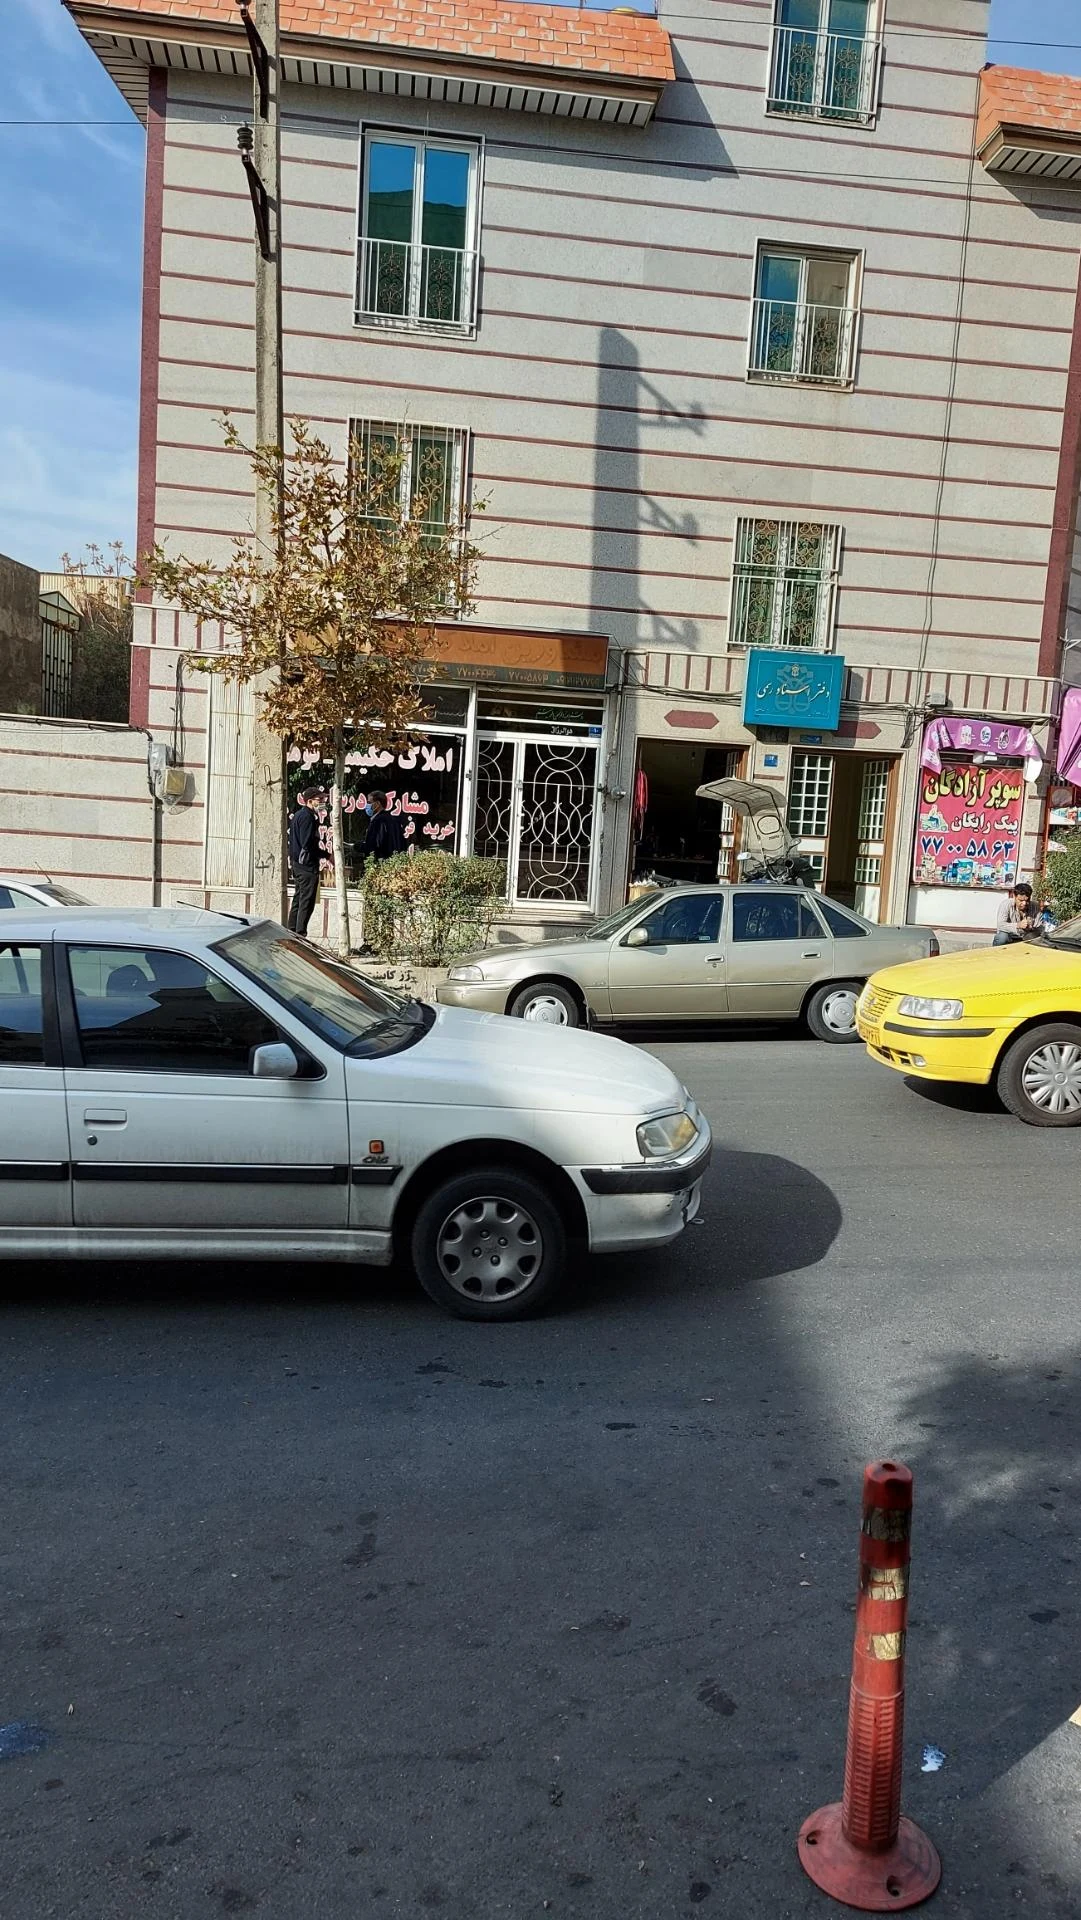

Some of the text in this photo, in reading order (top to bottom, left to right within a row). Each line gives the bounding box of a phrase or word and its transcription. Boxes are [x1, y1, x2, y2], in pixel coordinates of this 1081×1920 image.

[775, 683, 812, 698] اسناد
[809, 681, 831, 704] دفتر
[344, 746, 395, 774] حکیمی
[398, 745, 453, 771] املاک
[923, 768, 1022, 809] سوپر آزادگان
[385, 789, 430, 815] مشارک
[422, 820, 456, 841] خرید
[950, 811, 1019, 836] پیک رایگان
